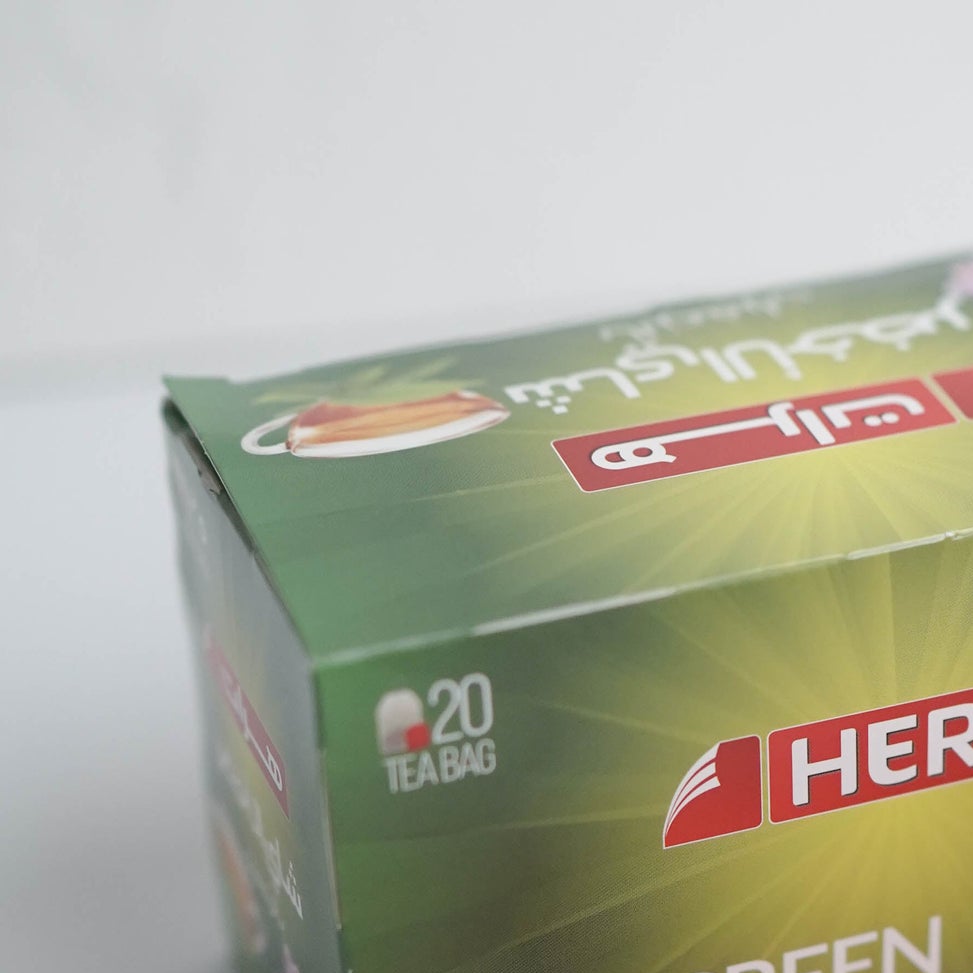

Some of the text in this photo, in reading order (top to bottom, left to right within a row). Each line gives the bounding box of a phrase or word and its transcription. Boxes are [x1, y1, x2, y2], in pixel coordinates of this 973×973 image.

[427, 672, 494, 745] 20
[384, 738, 497, 794] TEA BAG
